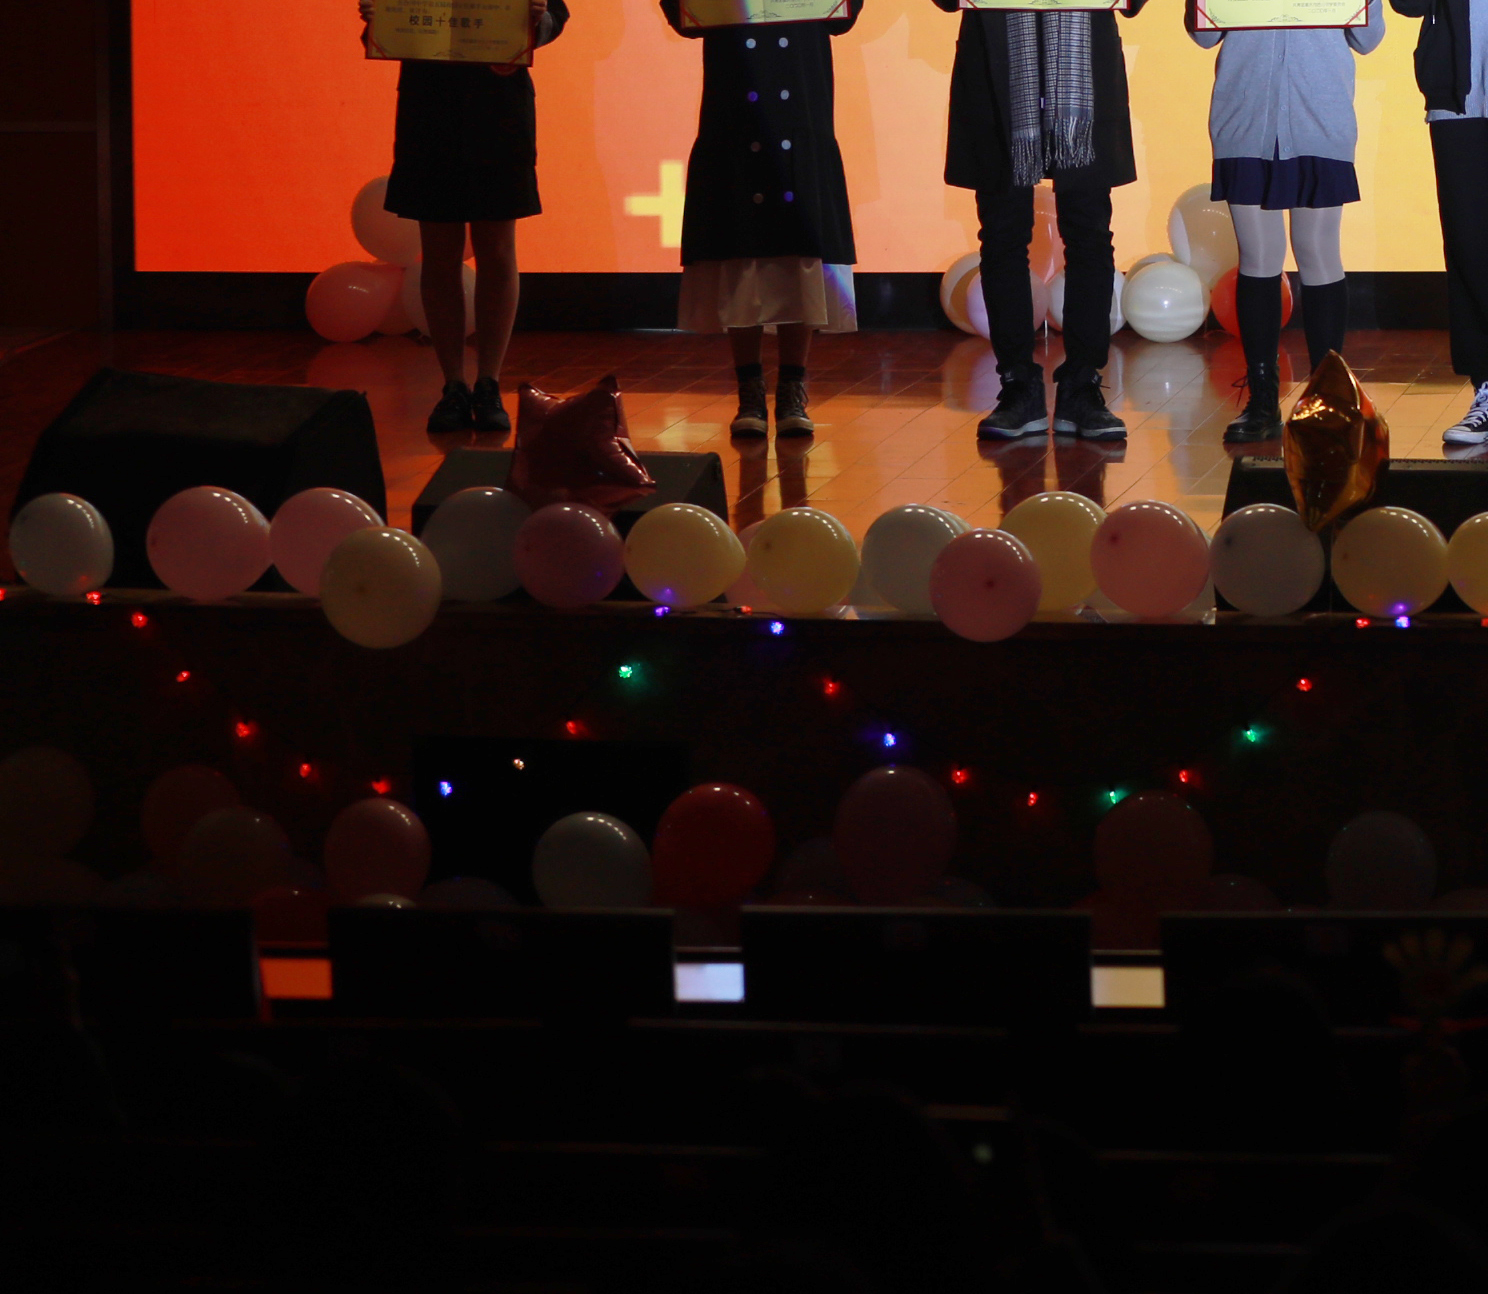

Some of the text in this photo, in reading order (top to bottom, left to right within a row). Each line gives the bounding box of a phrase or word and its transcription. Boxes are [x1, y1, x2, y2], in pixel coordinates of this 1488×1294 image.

[409, 15, 484, 29] 校园十佳歌手
